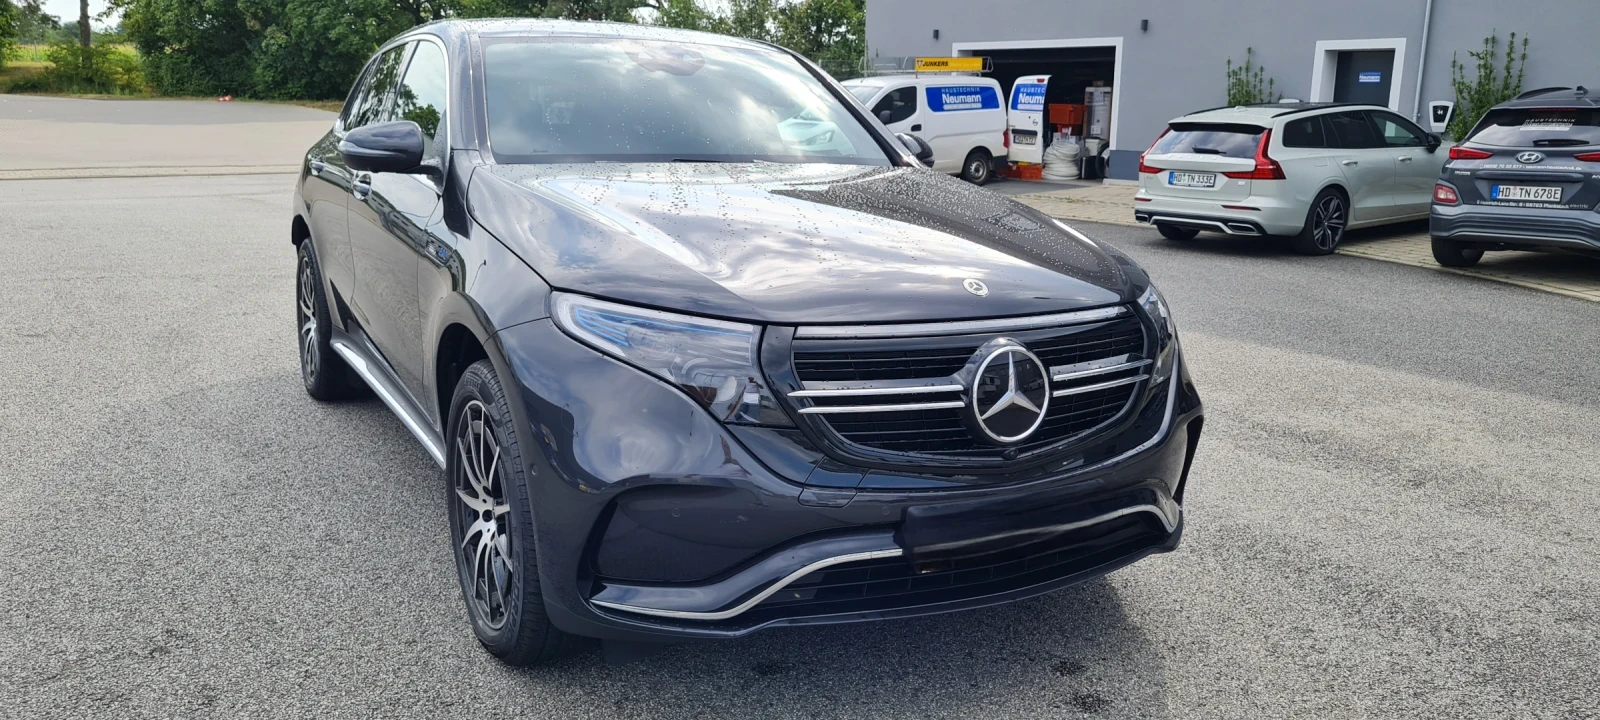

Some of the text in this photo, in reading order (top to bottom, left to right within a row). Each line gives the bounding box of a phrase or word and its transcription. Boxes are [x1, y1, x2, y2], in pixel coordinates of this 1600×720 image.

[941, 93, 982, 104] Neumann
[1173, 173, 1214, 184] HD TN 333E
[1498, 187, 1561, 200] HD TN 678E
